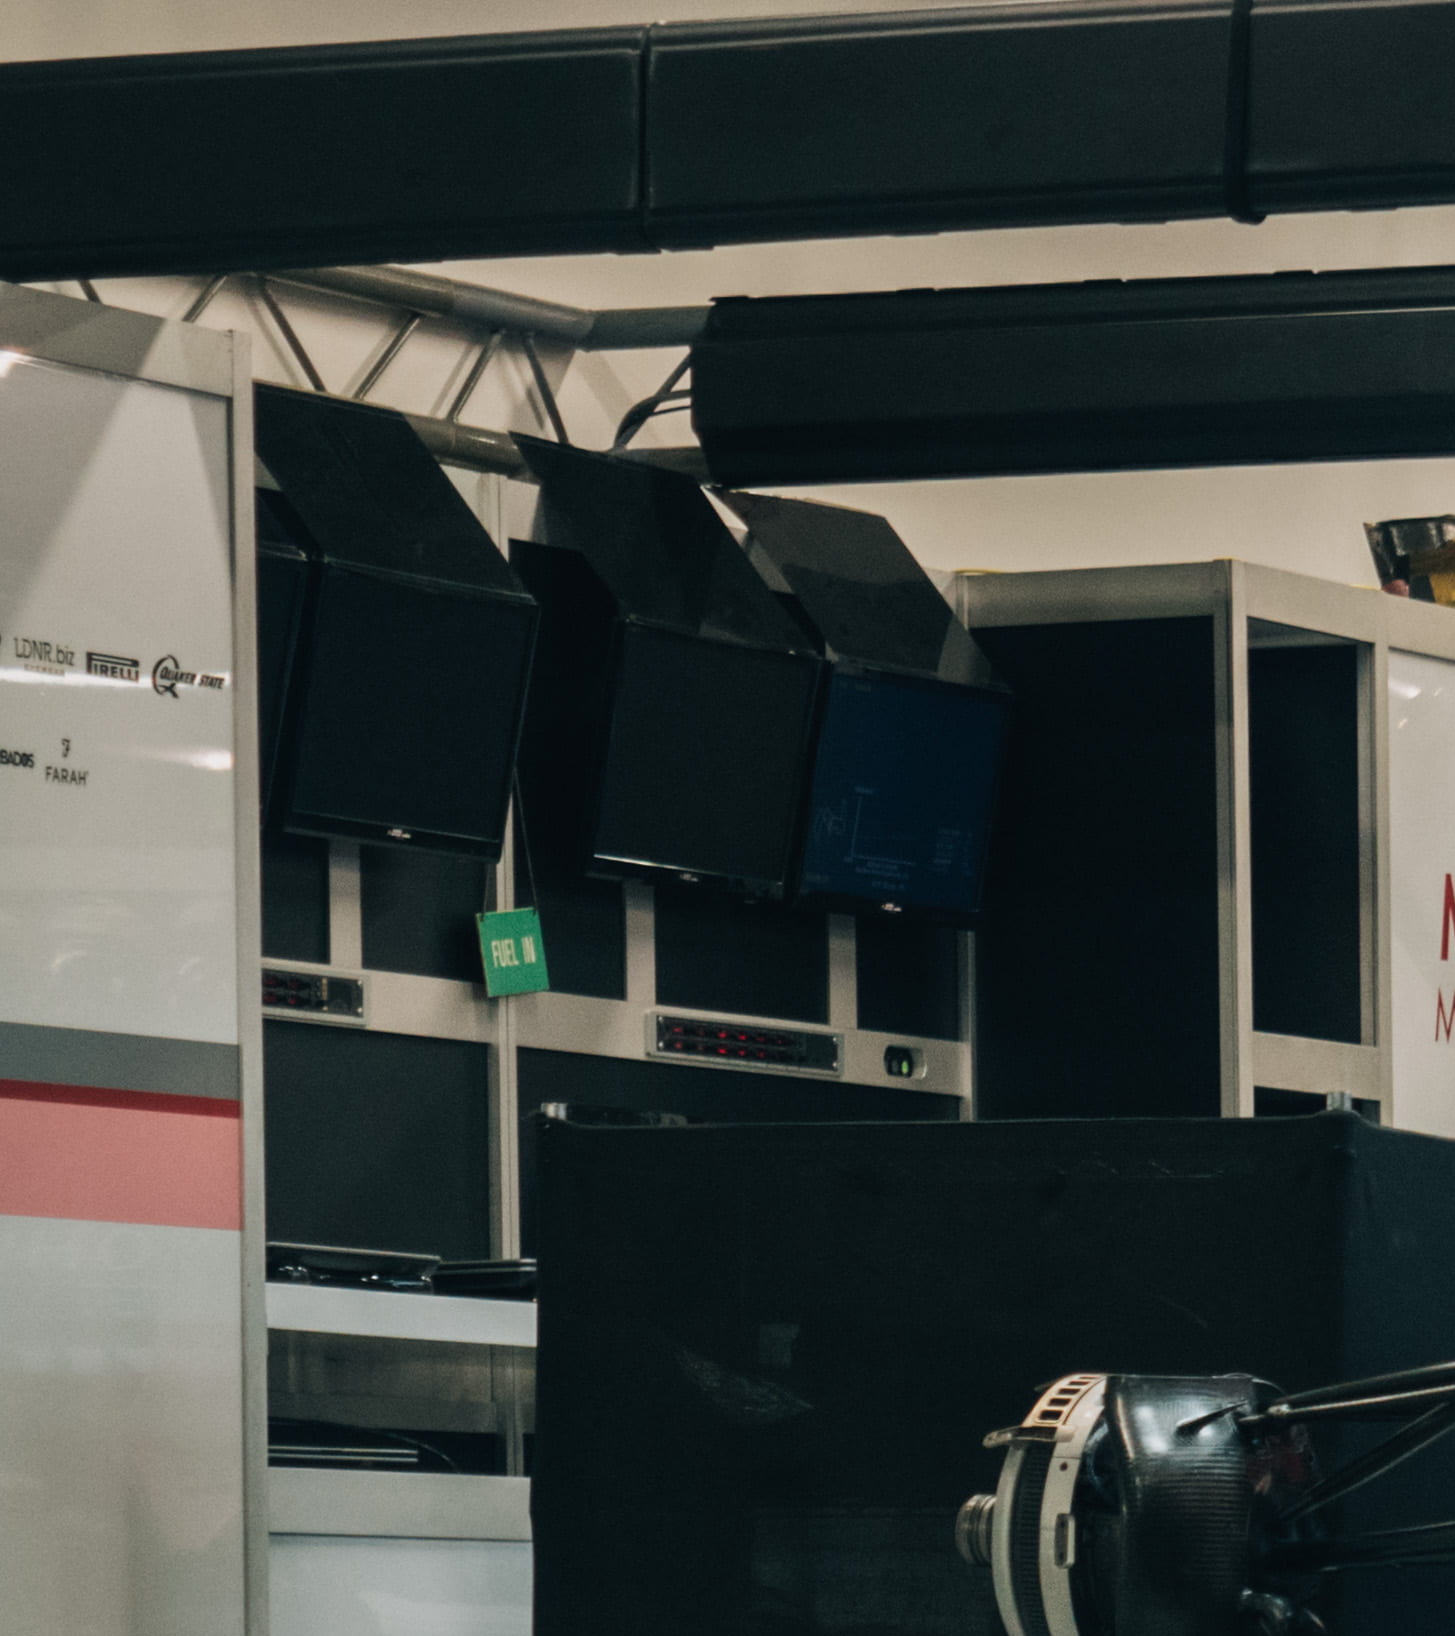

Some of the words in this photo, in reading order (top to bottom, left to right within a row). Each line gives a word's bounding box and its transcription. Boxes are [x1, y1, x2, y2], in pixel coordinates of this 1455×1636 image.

[86, 651, 140, 683] PIRELLI
[45, 766, 88, 787] FARAH
[491, 938, 519, 968] FUEL
[521, 935, 536, 964] IN
